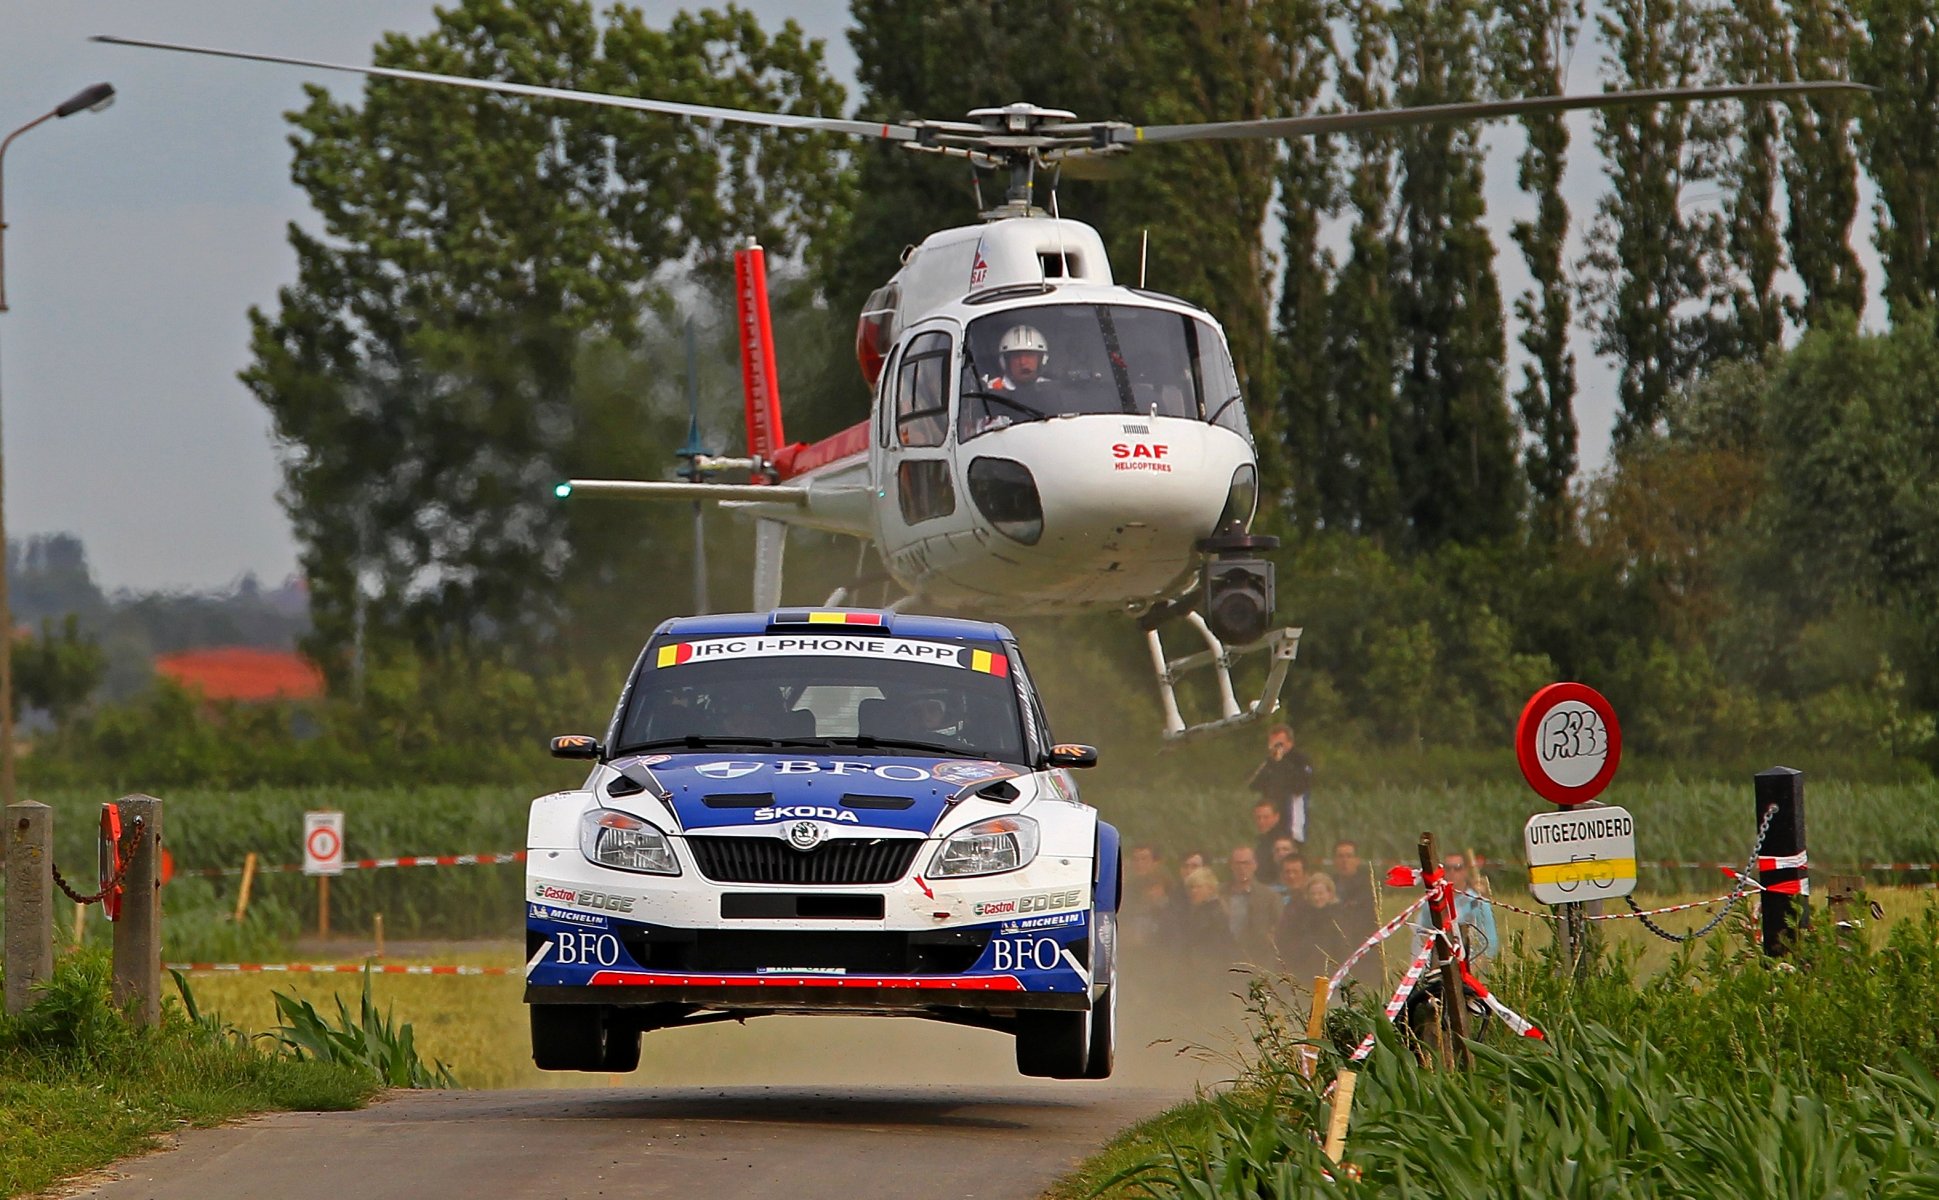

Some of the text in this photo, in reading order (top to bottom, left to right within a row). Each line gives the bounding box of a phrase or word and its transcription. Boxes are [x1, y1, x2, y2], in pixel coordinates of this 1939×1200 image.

[1112, 443, 1168, 459] SAF
[1115, 462, 1171, 472] HELICOPTERES
[695, 640, 954, 659] IRC I-PHONE APP
[774, 760, 931, 781] BFO
[754, 806, 859, 822] ŠKODA
[1530, 818, 1632, 844] UITGEZONDERD
[544, 886, 637, 913] Castrol EDGE
[984, 890, 1081, 914] Castrol EDGE
[550, 909, 604, 924] MICHELIN
[1021, 913, 1079, 929] MICHELIN
[556, 932, 619, 966] BFO
[992, 938, 1061, 971] BFO
